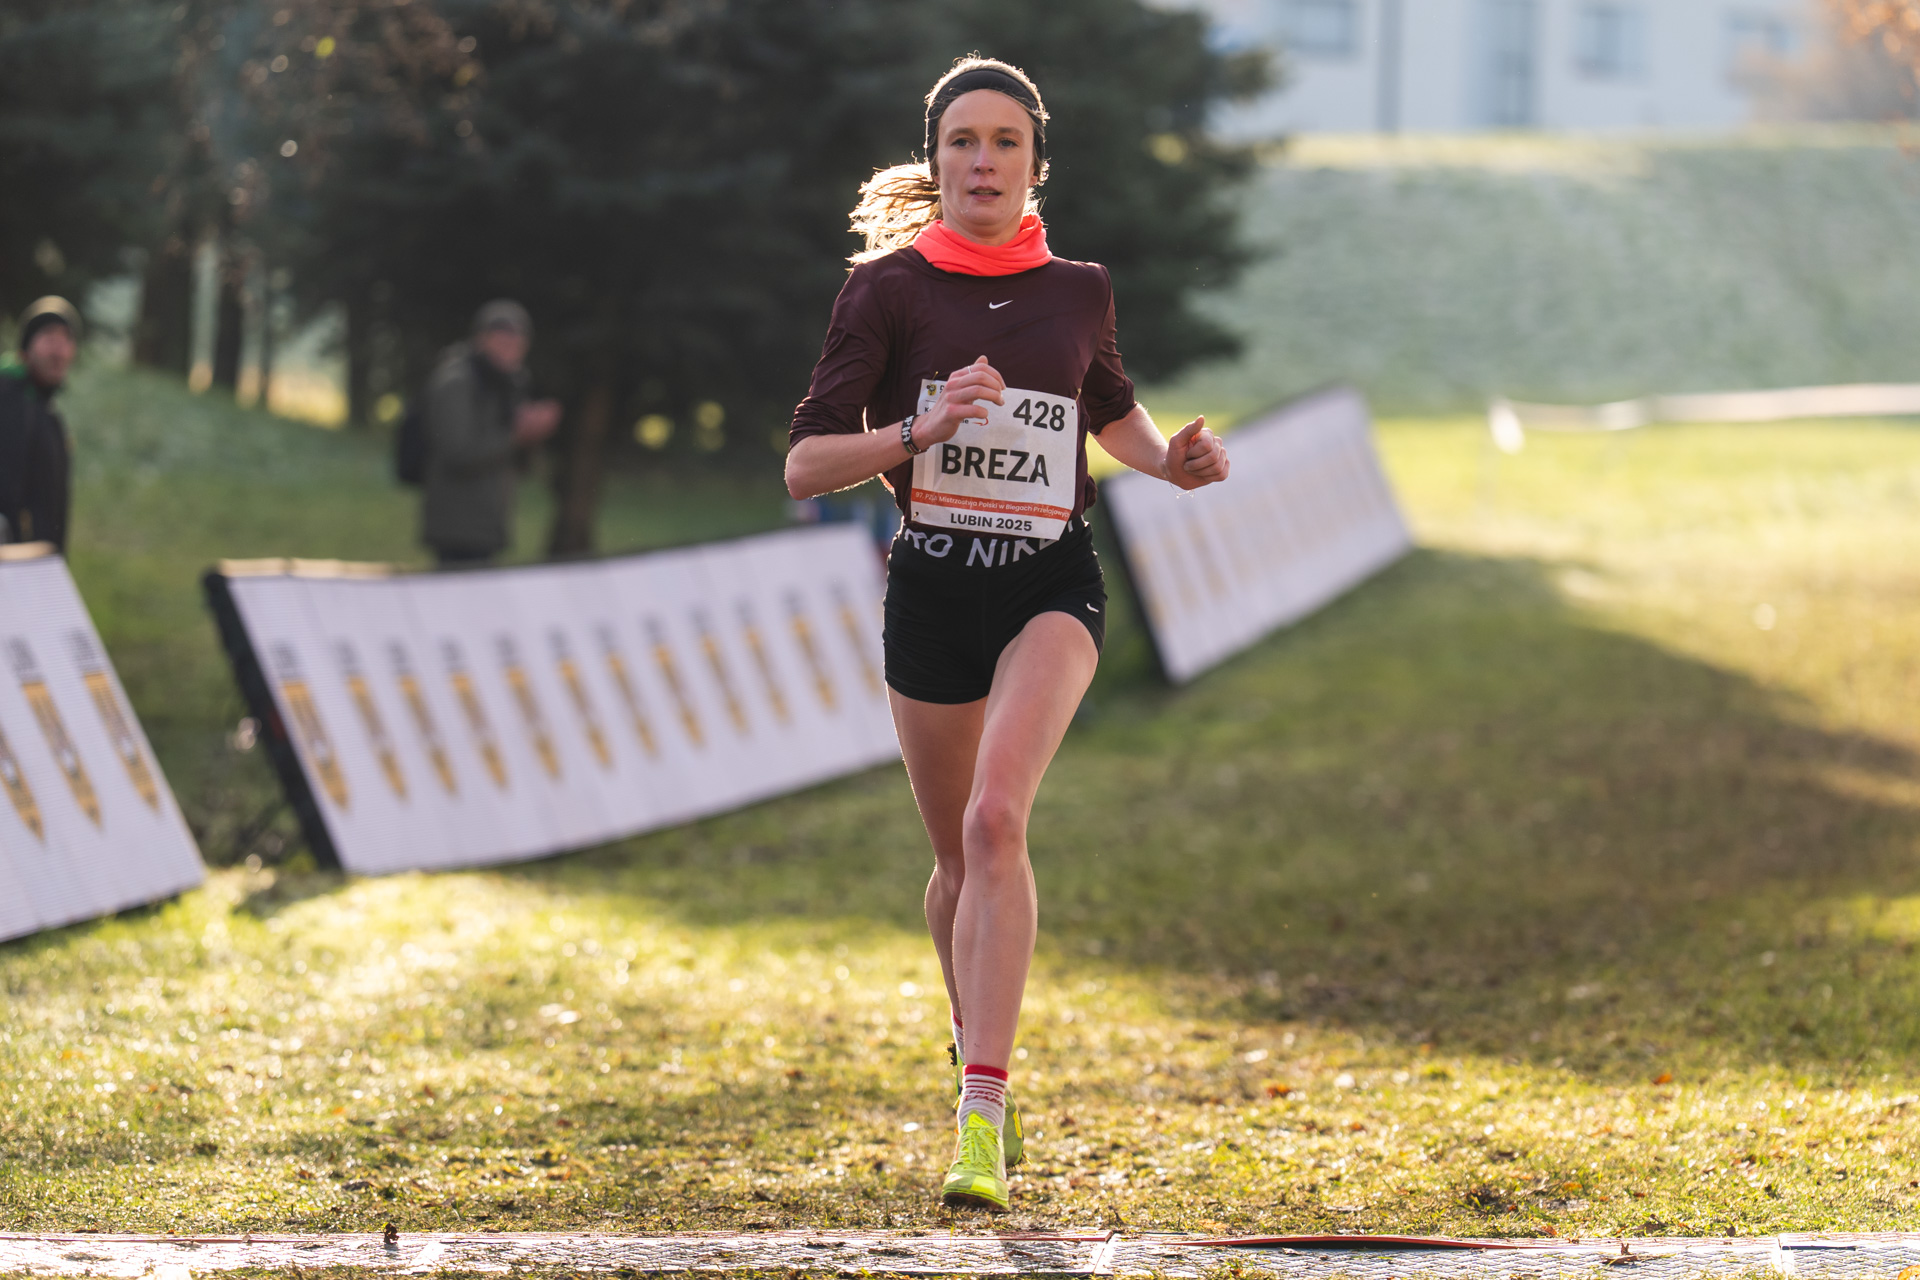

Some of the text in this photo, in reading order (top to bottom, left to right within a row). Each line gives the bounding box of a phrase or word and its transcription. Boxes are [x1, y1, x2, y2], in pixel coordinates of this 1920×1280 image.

[1013, 398, 1066, 432] 428
[941, 443, 1050, 487] BREZA
[979, 500, 998, 509] Polski
[1006, 503, 1032, 512] Biegach
[950, 512, 1033, 532] LUBIN 2025
